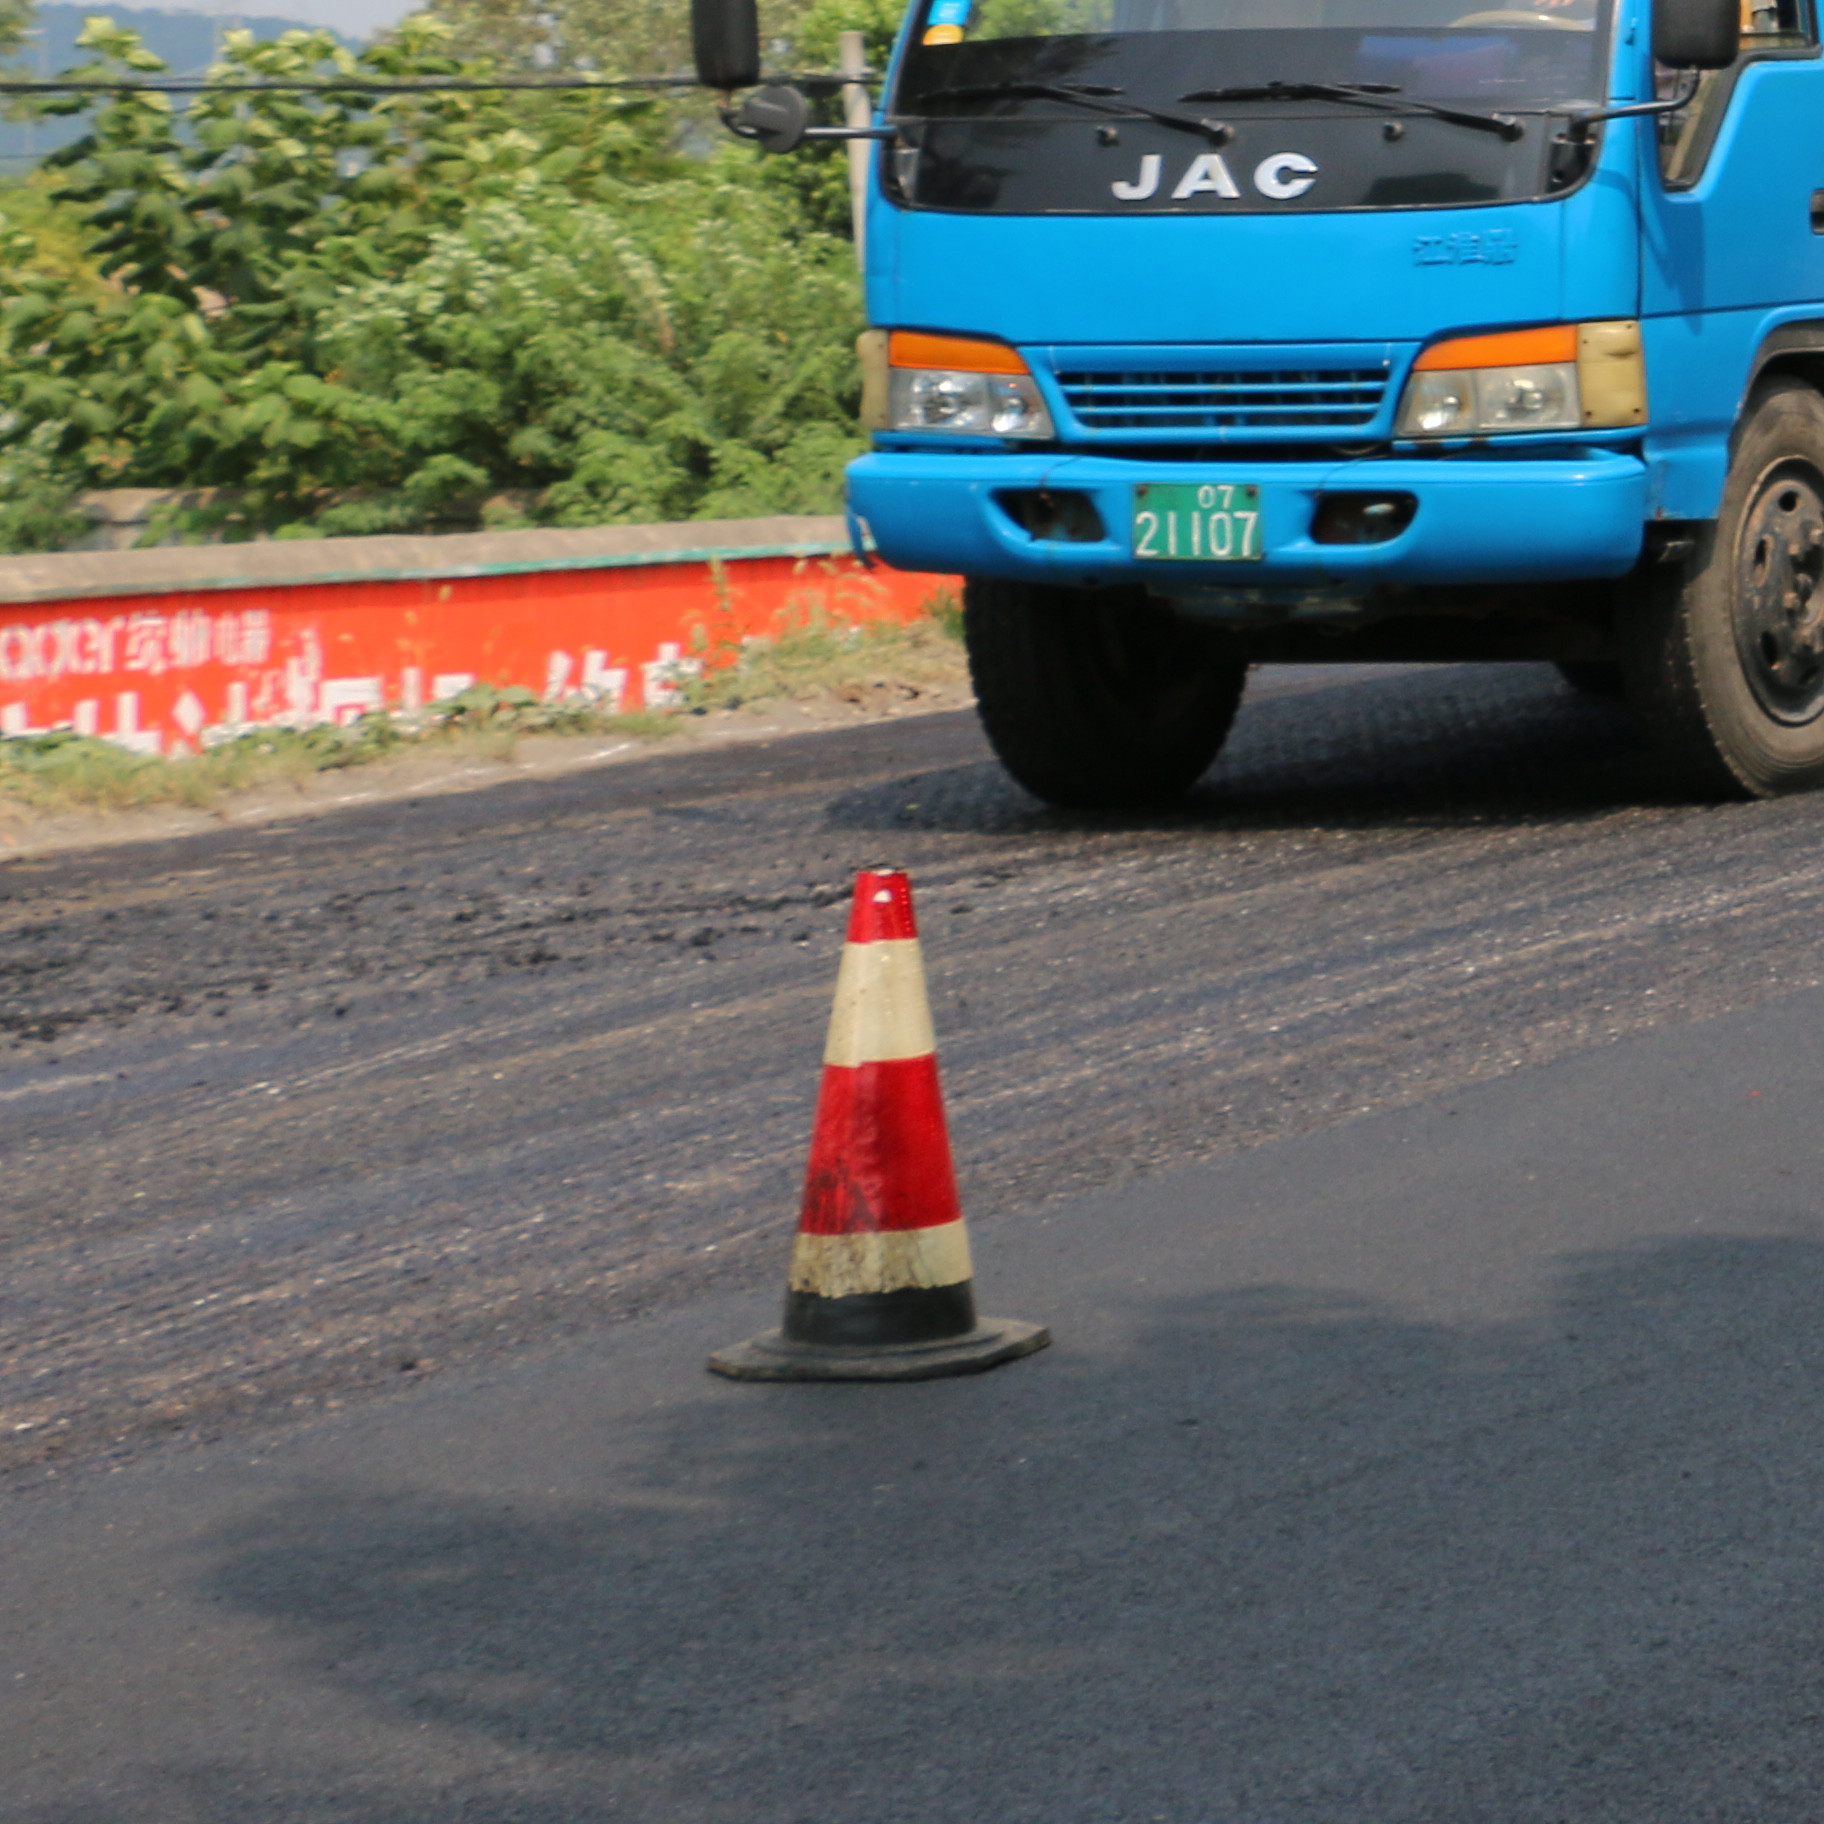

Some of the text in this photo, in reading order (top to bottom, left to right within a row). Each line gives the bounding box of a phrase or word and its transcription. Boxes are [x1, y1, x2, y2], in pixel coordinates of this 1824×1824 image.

[1111, 152, 1318, 200] JAC
[1198, 485, 1234, 509] 07
[1135, 510, 1258, 557] 21107
